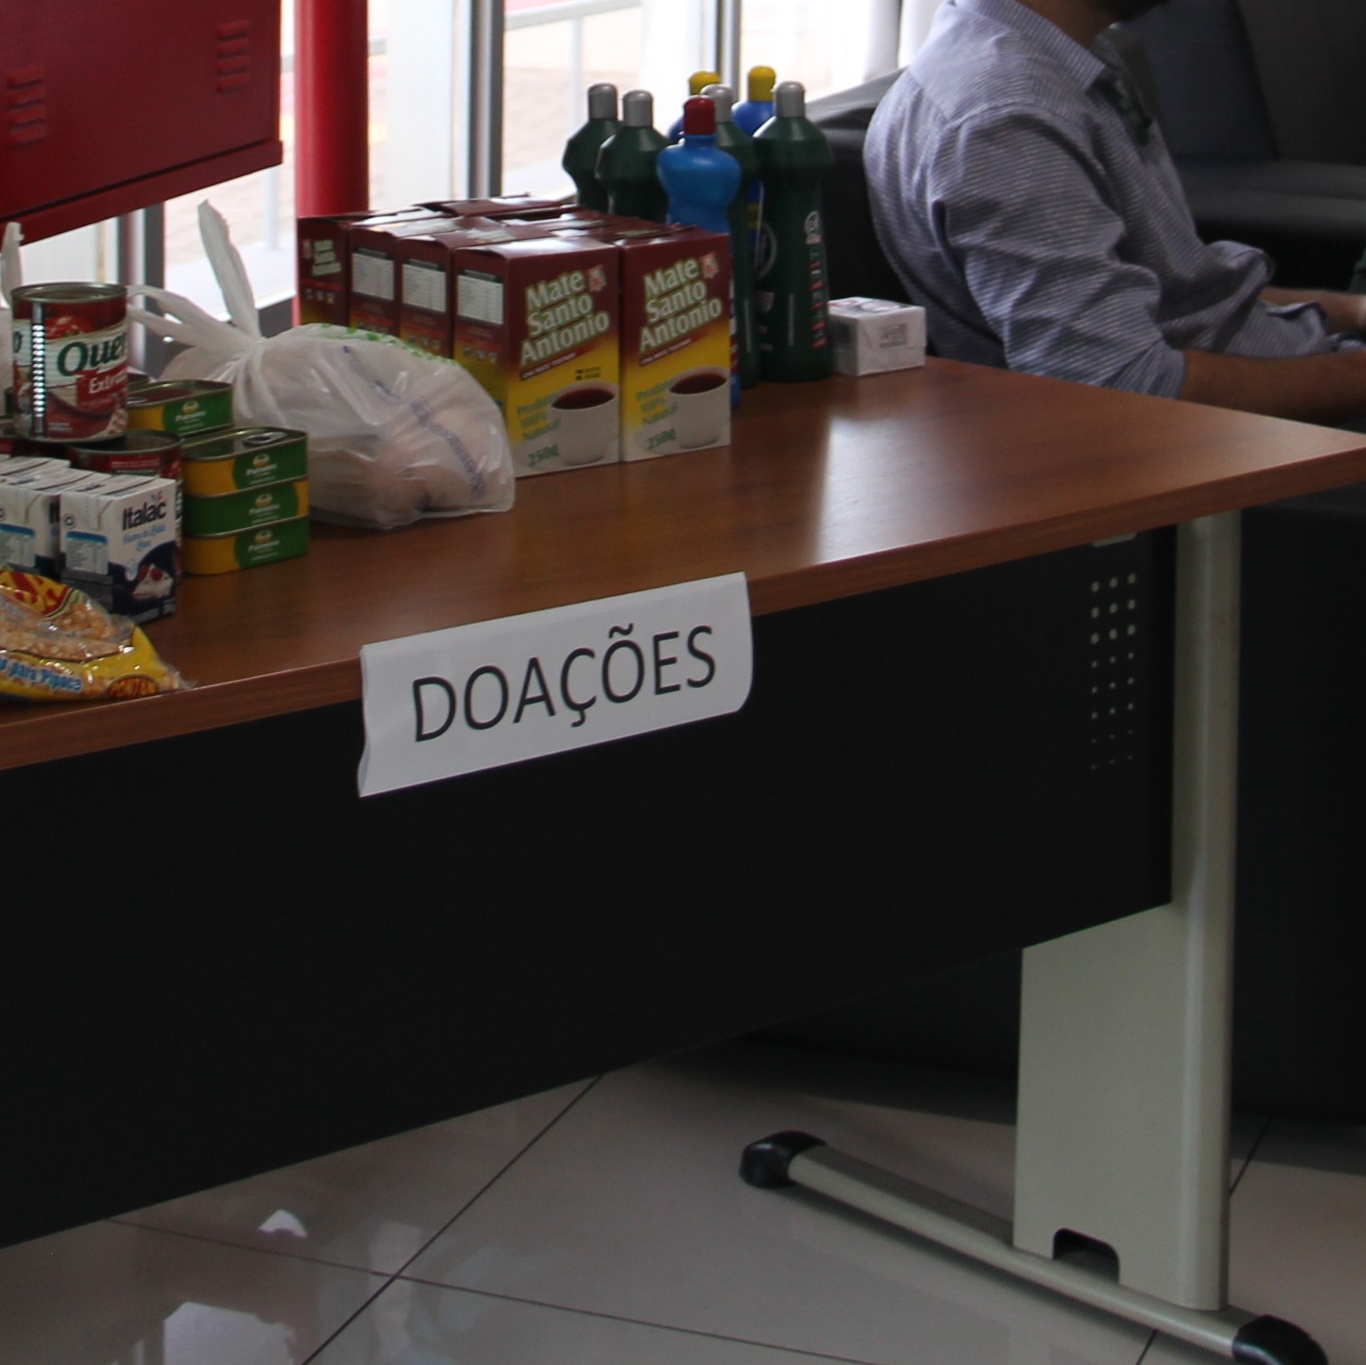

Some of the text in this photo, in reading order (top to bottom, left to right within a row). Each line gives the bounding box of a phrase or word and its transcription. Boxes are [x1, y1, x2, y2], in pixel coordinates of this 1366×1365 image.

[525, 270, 584, 310] Mate
[642, 257, 699, 298] Mate
[527, 293, 593, 337] Santo
[644, 281, 708, 324] Santo
[520, 311, 611, 367] Antonio
[639, 297, 723, 353] Antonio
[121, 500, 167, 531] Italac
[412, 623, 717, 744] DOAÇÕES
